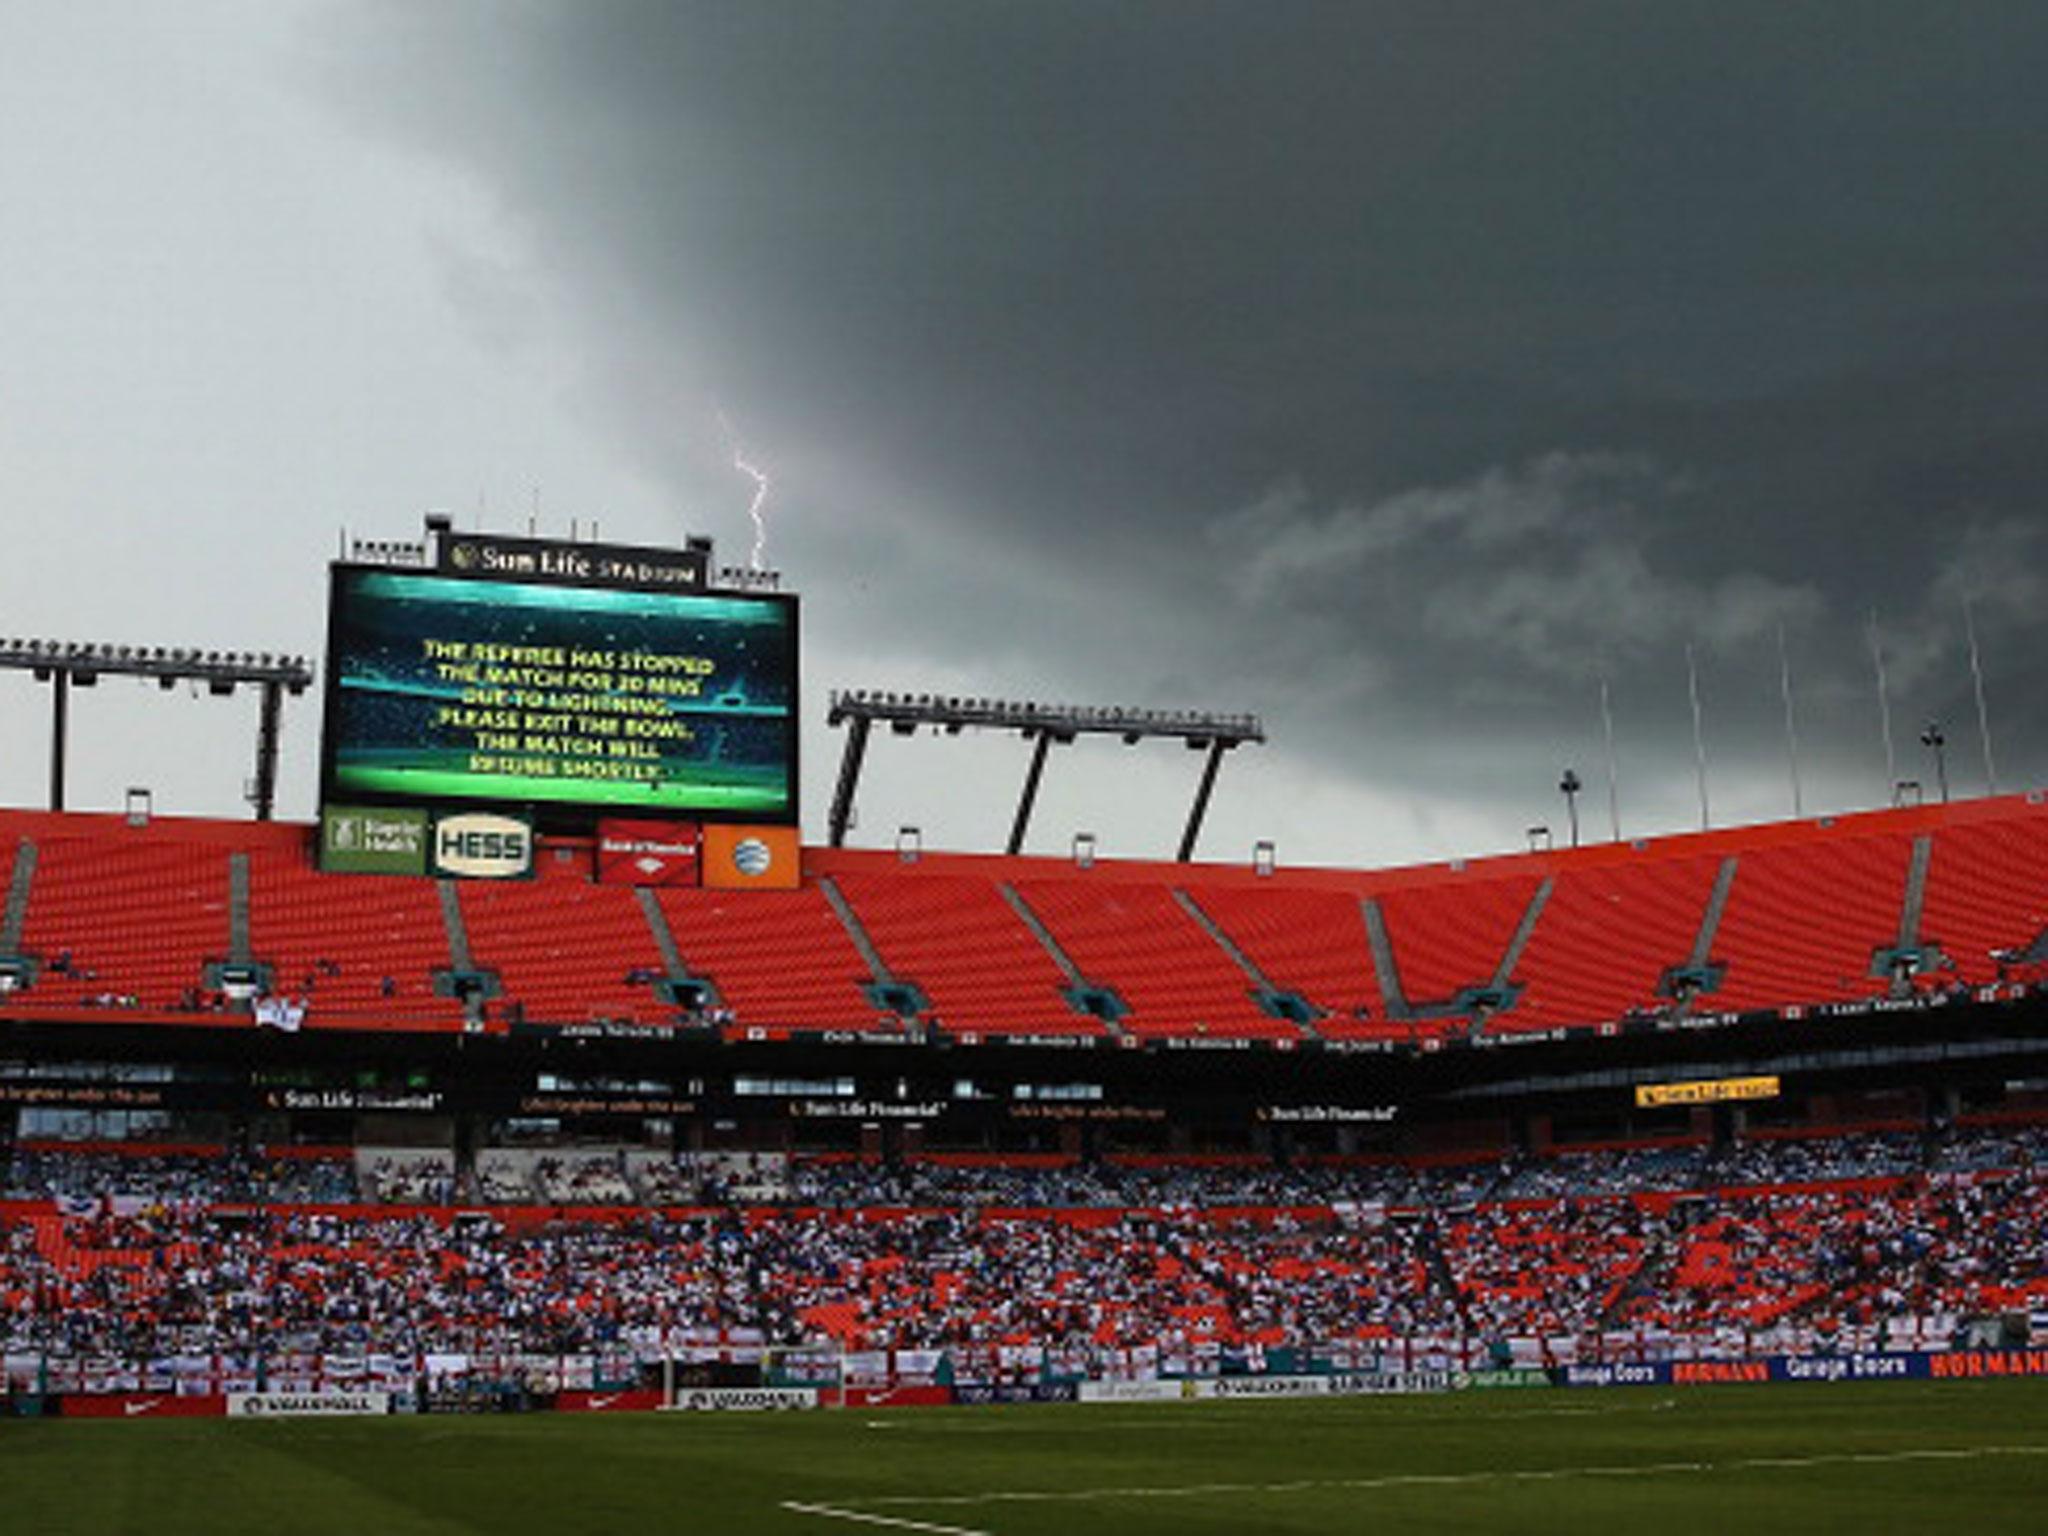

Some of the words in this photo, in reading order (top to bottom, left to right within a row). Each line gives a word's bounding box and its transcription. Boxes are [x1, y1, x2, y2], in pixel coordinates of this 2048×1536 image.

[482, 548, 535, 571] Sun
[540, 551, 591, 577] Life
[424, 640, 467, 658] THE
[571, 651, 614, 669] HAS
[620, 653, 713, 675] STOPPED
[437, 662, 478, 682] THE
[485, 667, 563, 687] MATCH
[567, 672, 612, 689] FOR
[513, 689, 542, 706] TO
[439, 706, 519, 729] PLEASE
[525, 714, 572, 732] EXIT
[578, 715, 618, 736] THE
[475, 731, 518, 750] THE
[524, 734, 602, 755] MATCH
[608, 741, 661, 758] WILL
[442, 829, 523, 859] HESS
[1787, 1355, 1848, 1381] Garage
[1852, 1353, 1906, 1376] Doors
